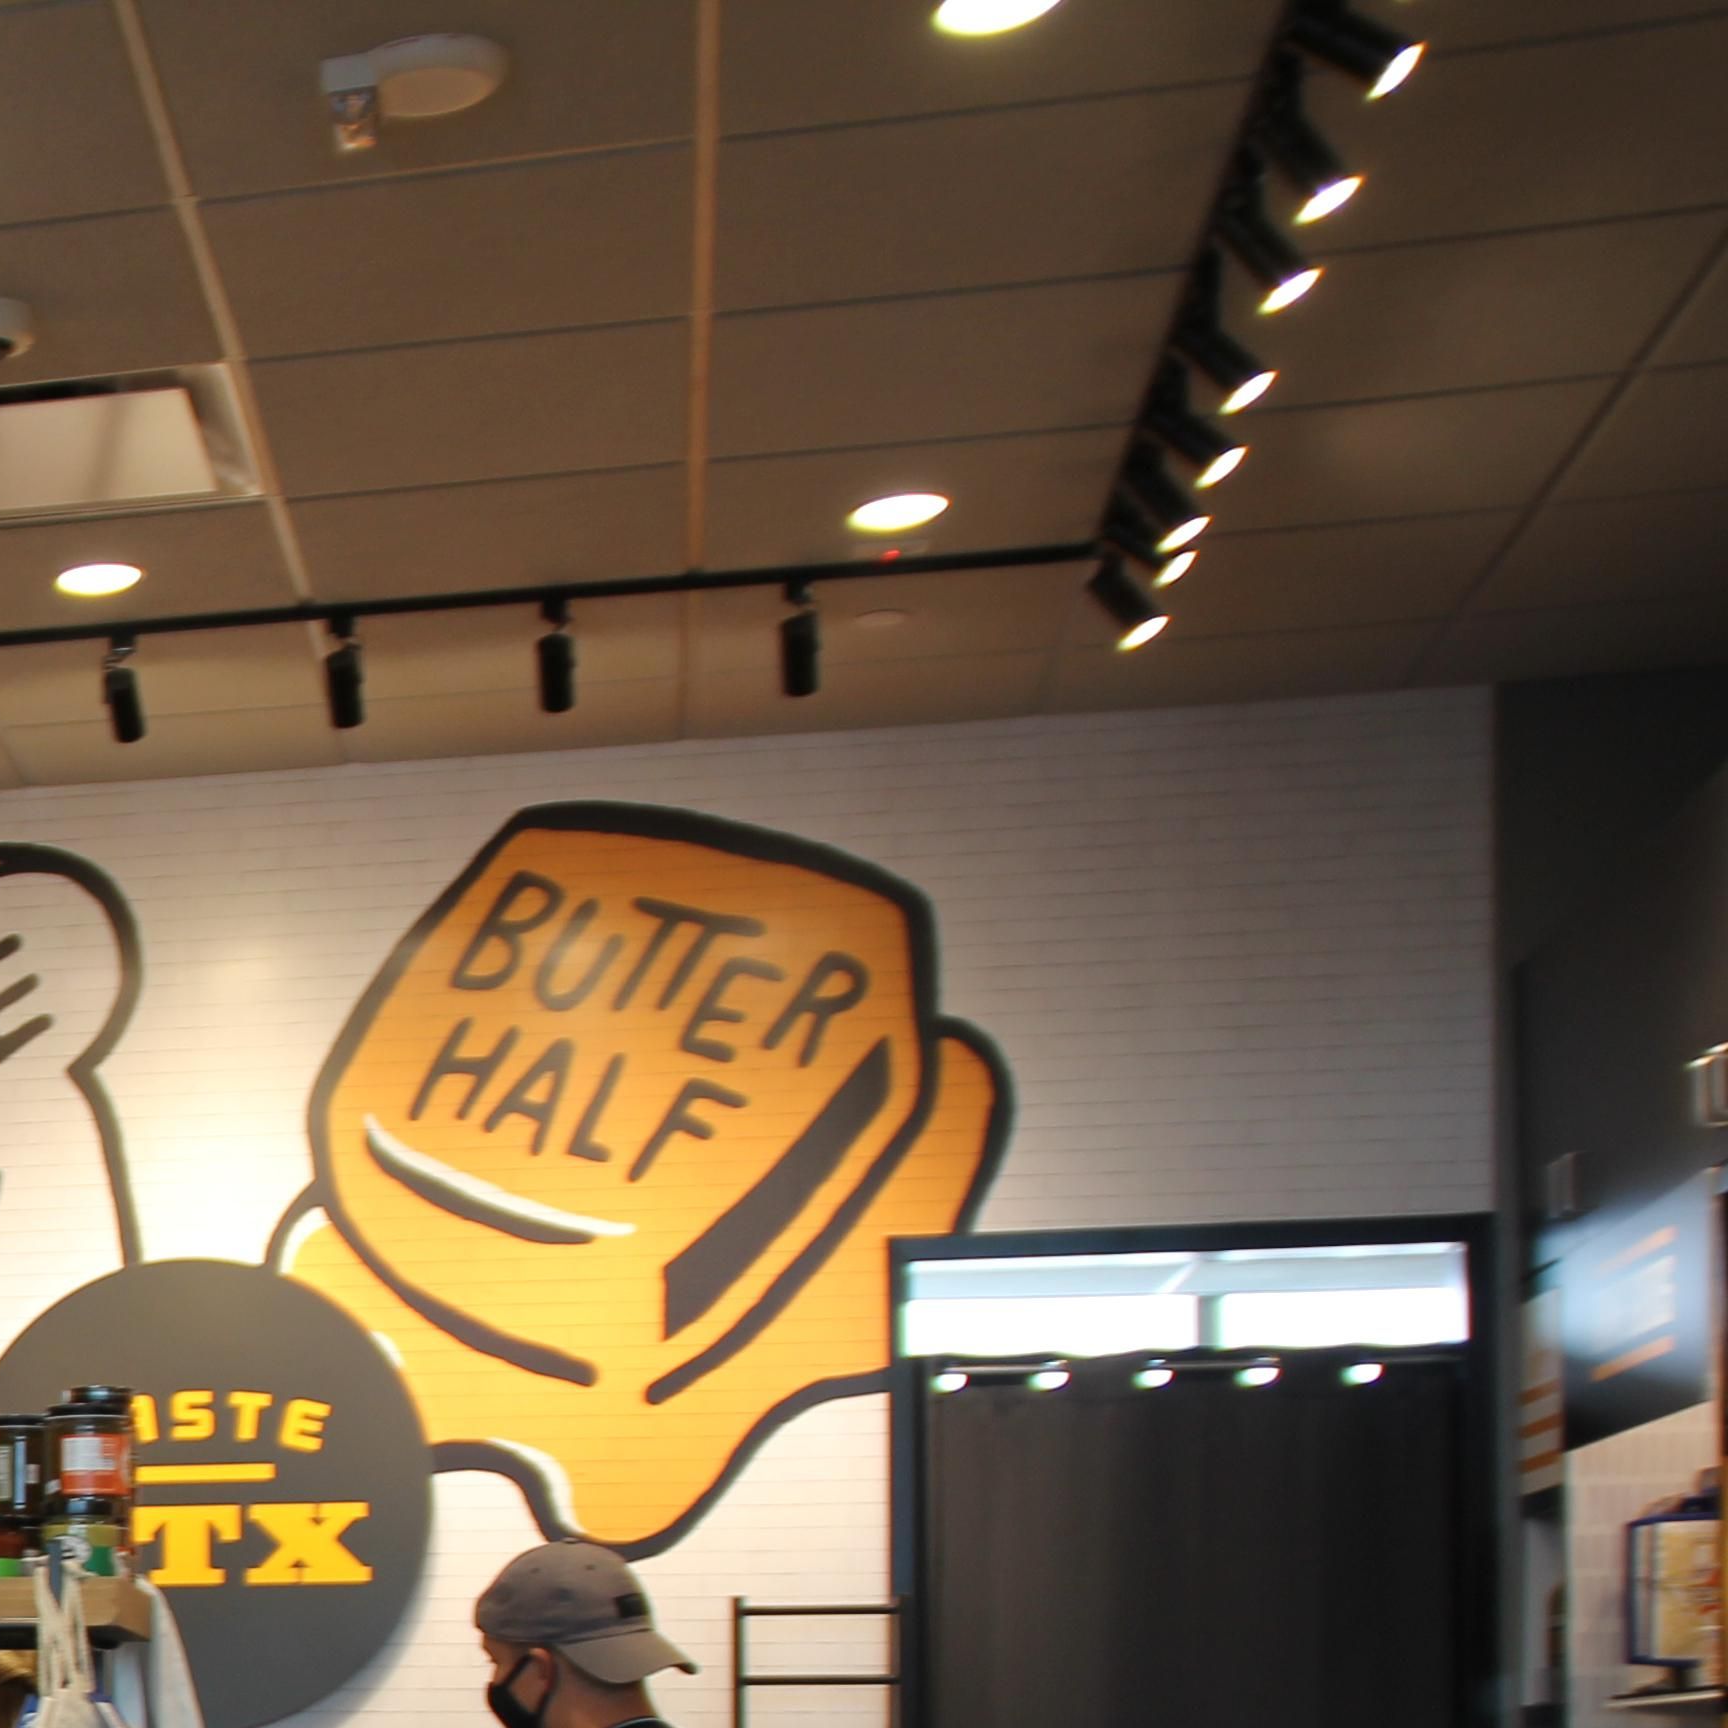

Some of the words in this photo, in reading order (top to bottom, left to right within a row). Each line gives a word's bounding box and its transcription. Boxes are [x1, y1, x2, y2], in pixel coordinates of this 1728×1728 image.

[449, 870, 869, 1067] BUTTER
[409, 1018, 749, 1182] HALF
[130, 1388, 334, 1453] ASTE
[130, 1502, 374, 1587] TX
